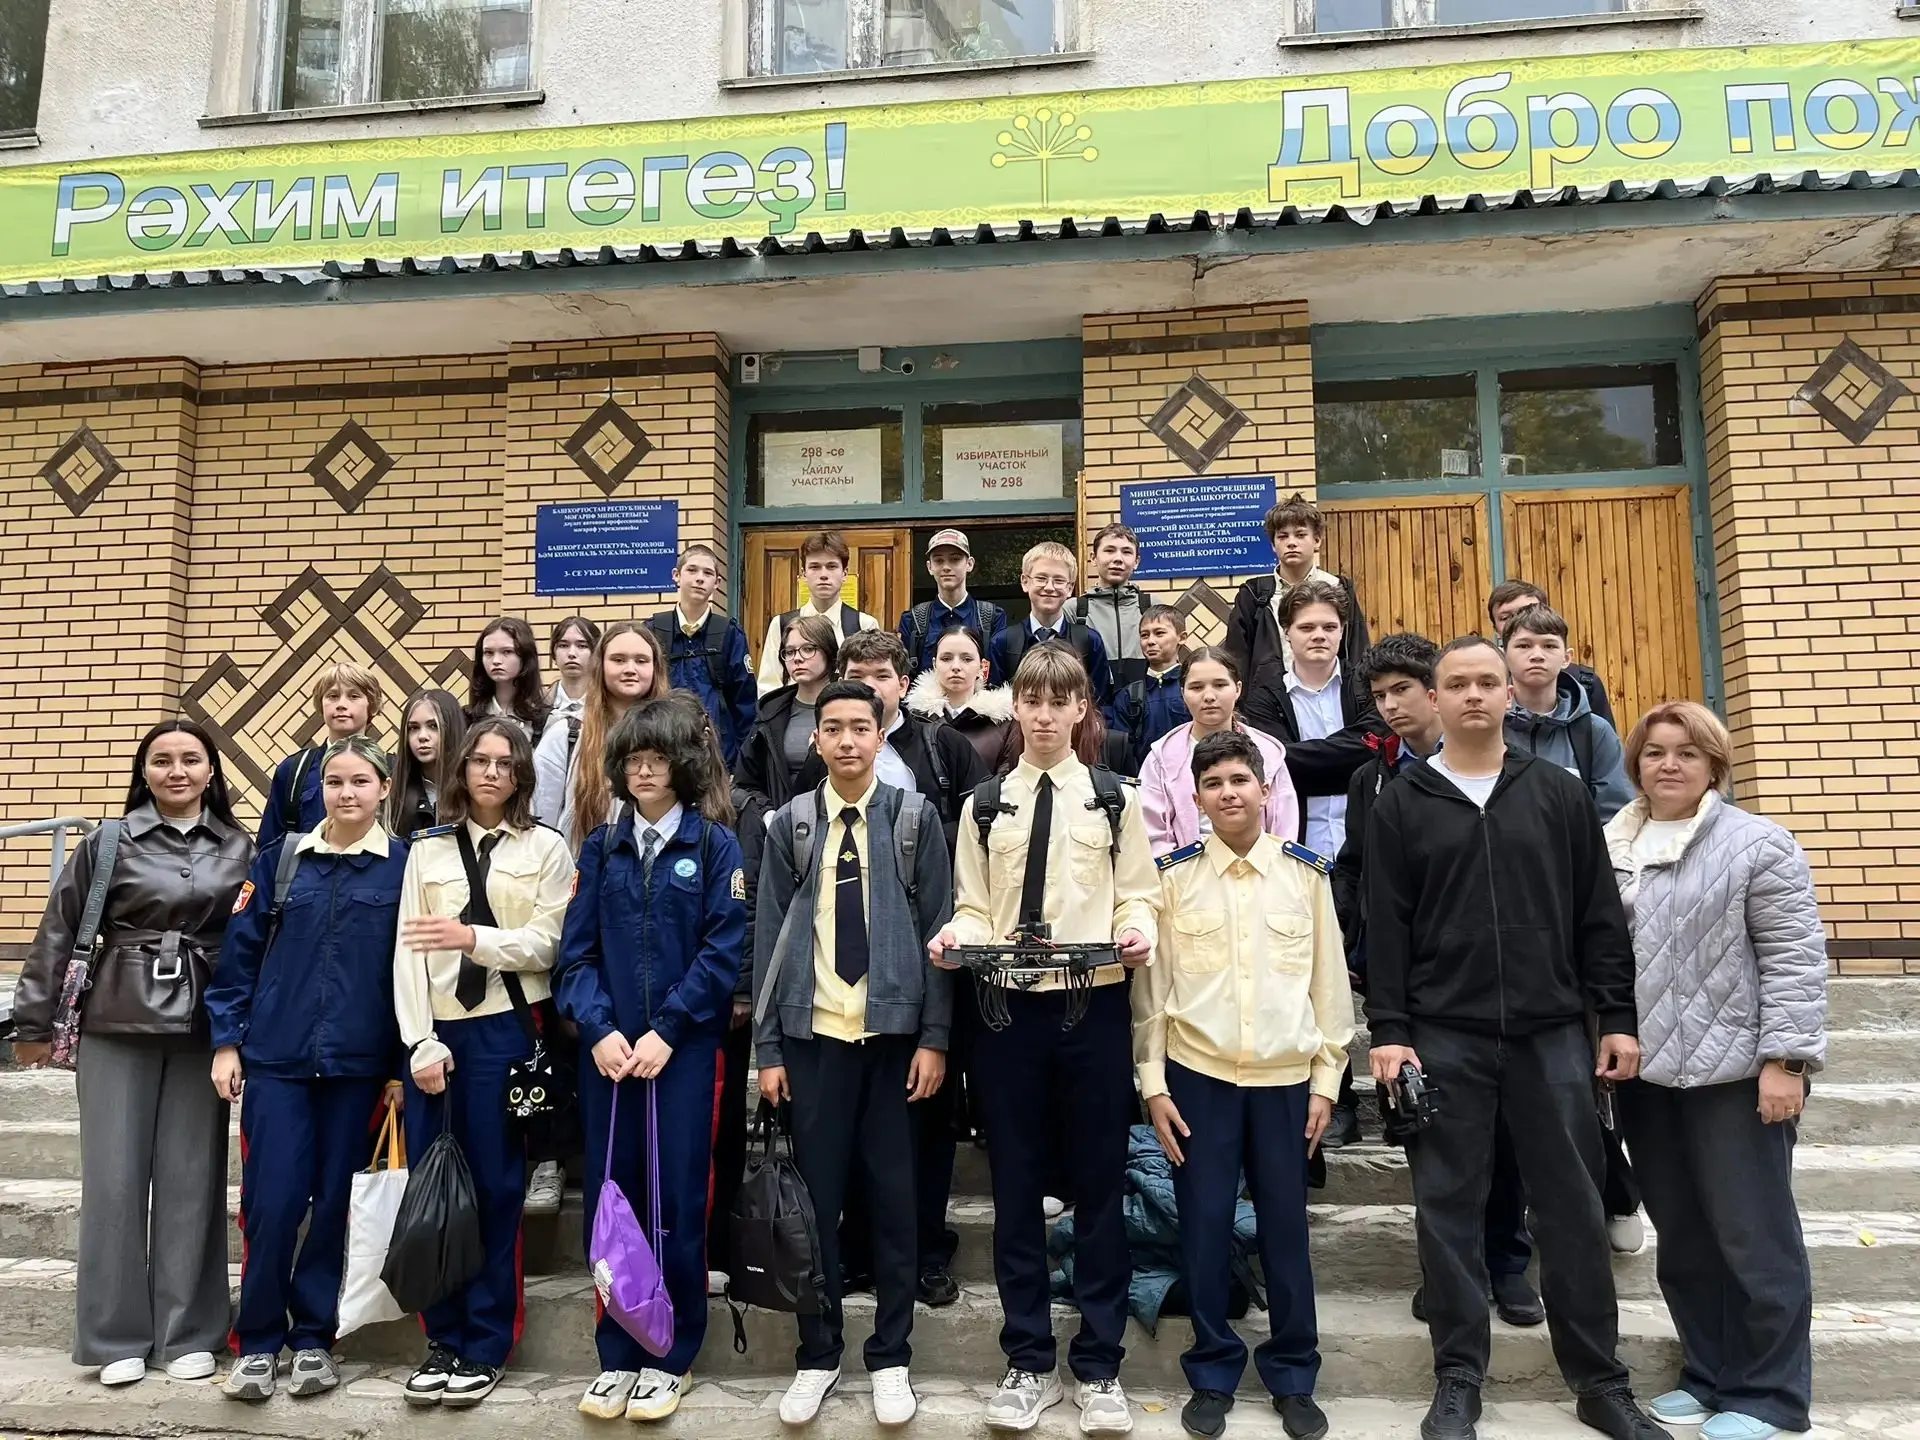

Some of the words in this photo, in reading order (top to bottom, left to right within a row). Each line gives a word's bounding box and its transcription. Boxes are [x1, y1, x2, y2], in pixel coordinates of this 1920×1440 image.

[1267, 72, 1682, 203] Добро
[51, 171, 399, 257] Рәхим
[440, 121, 848, 235] итегеҙ!
[801, 447, 822, 458] 298
[956, 447, 1049, 461] ИЗБИРАТЕЛЬНЫЙ
[978, 460, 1027, 471] УЧАСТОК
[982, 477, 997, 488] №
[1000, 476, 1023, 488] 298
[1130, 486, 1199, 498] МИНИСТЕРСТВО
[1200, 484, 1266, 494] ПРОСВЕЩЕНИЯ
[1131, 495, 1188, 506] РЕСПУБЛИКИ
[1189, 492, 1260, 502] БАШКОРТОСТАН
[1133, 523, 1178, 533] ШКИРСКИЙ
[1178, 522, 1216, 531] КОЛЛЕДЖ
[1167, 529, 1232, 539] СТРОИТЕЛЬСТВА
[1146, 537, 1216, 547] КОММУНАЛЬНОГО
[1216, 534, 1261, 544] ХОЗЯЙСТВА
[1153, 549, 1196, 559] УЧЕБНЫЙ
[1197, 547, 1232, 557] КОРПУС
[1243, 547, 1248, 555] 3
[608, 567, 648, 575] КОРПУСЫ
